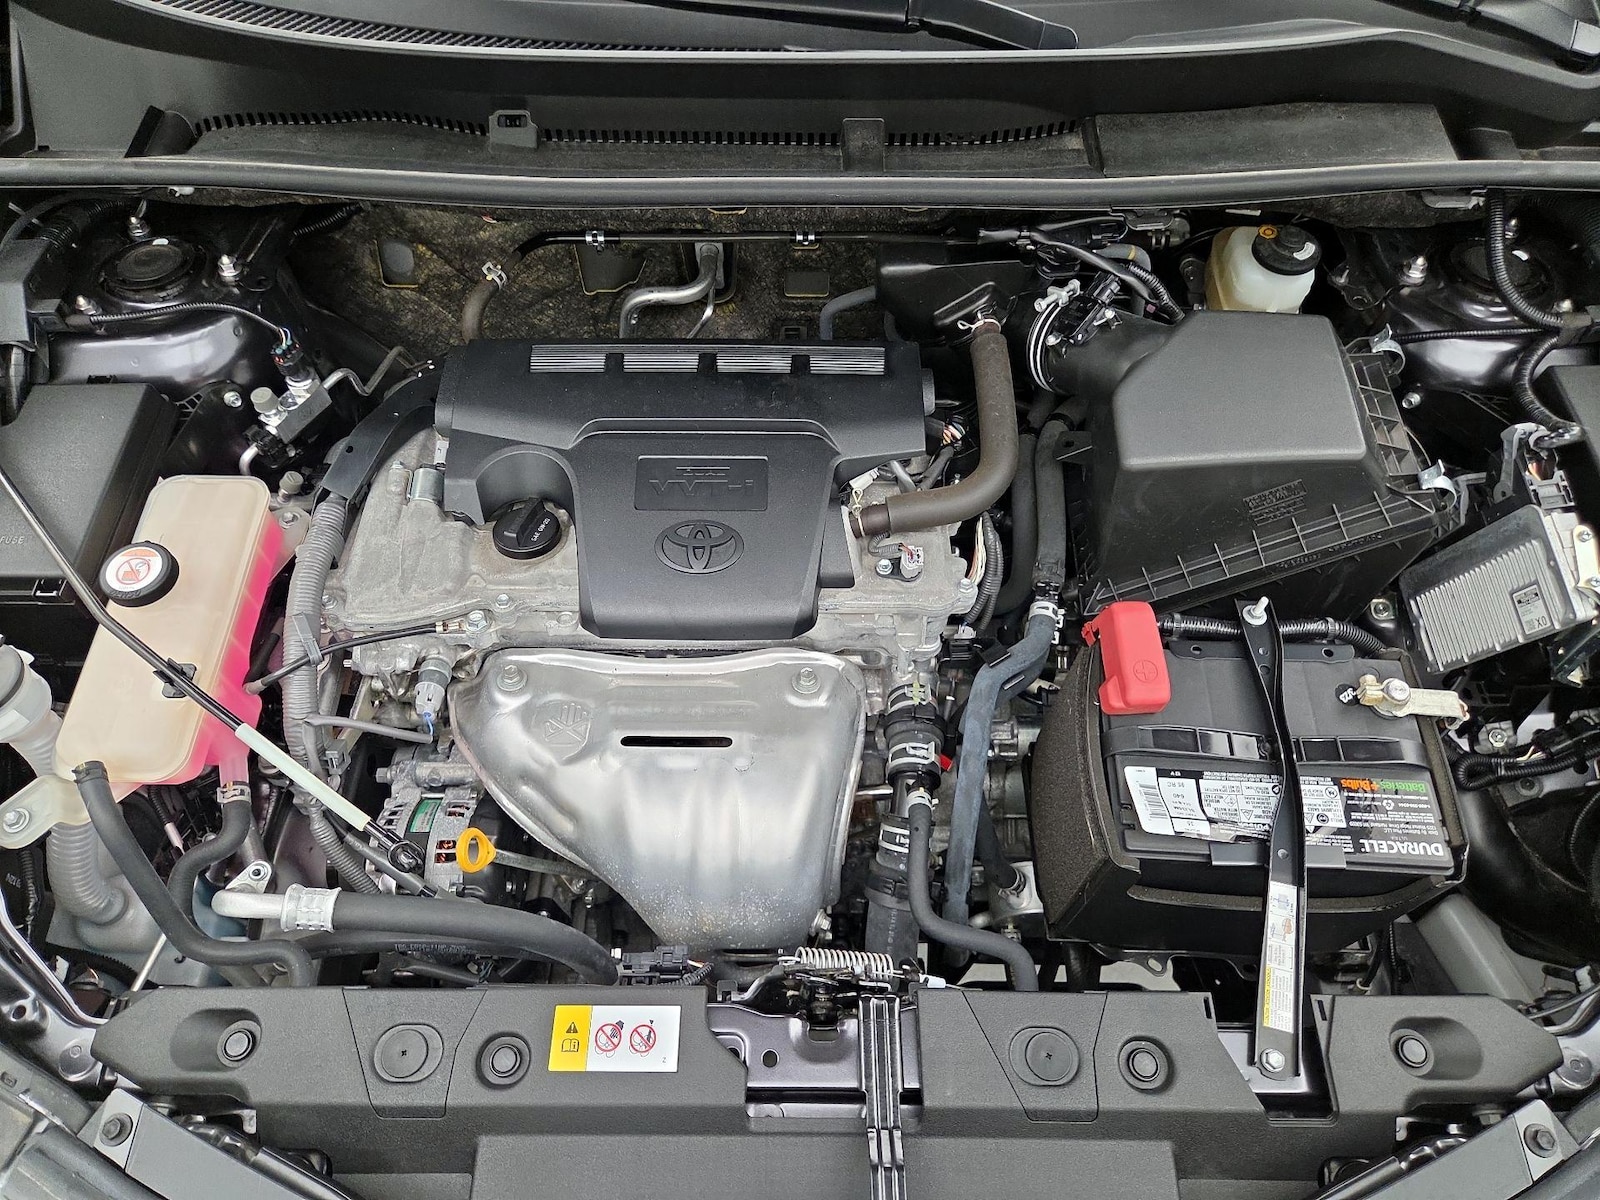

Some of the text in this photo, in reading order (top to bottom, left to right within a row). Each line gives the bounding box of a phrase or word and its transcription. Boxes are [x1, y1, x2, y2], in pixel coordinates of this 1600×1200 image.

[648, 479, 754, 496] VVT-i
[0, 535, 25, 544] FUSE
[530, 529, 541, 542] SAE
[1380, 782, 1425, 793] Batteries
[1359, 839, 1444, 856] DURACELL
